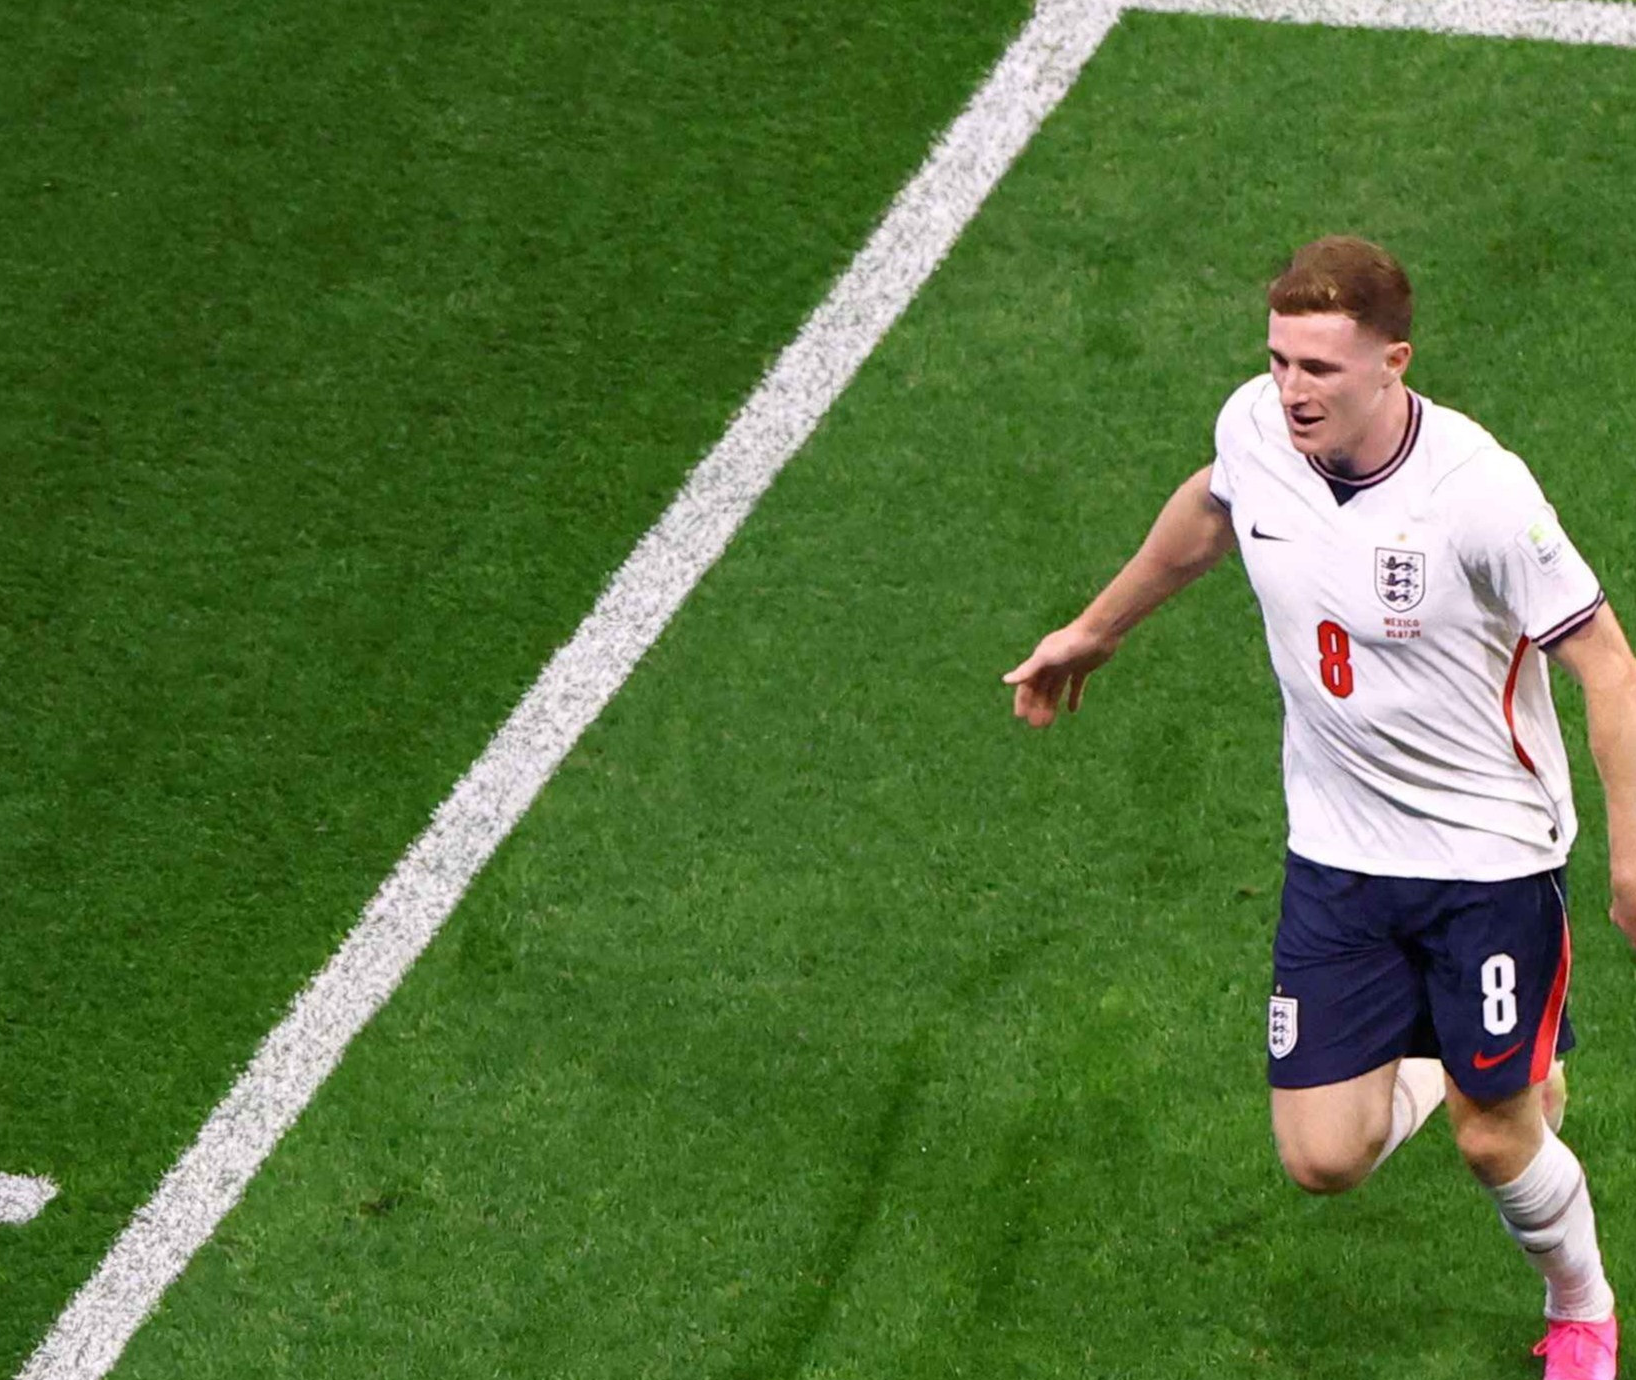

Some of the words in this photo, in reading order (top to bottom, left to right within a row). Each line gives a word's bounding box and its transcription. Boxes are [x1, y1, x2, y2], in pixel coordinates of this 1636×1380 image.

[1317, 620, 1354, 698] 8
[1383, 617, 1420, 627] MEXICO
[1481, 953, 1518, 1036] 8
